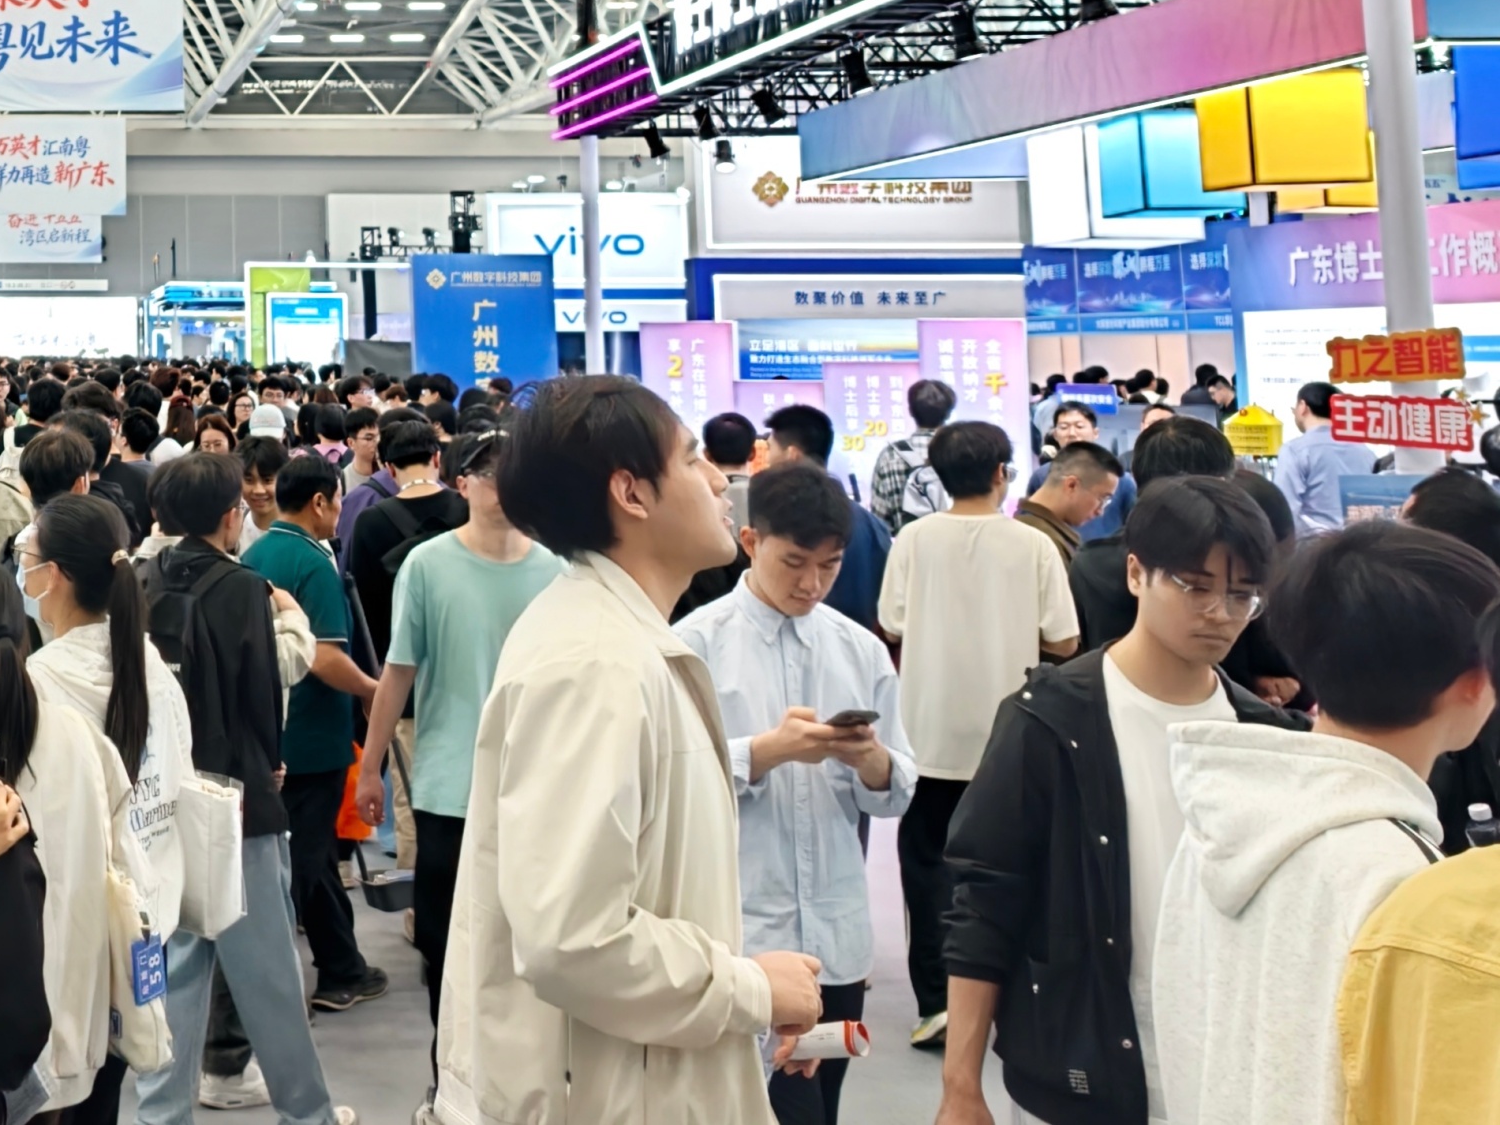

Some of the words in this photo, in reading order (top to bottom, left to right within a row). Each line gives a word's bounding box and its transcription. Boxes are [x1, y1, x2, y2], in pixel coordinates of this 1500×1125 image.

[795, 291, 864, 305] 数聚价值
[877, 291, 946, 305] 未来至广
[1331, 334, 1462, 379] 力之智能
[1334, 399, 1468, 446] 主动健康
